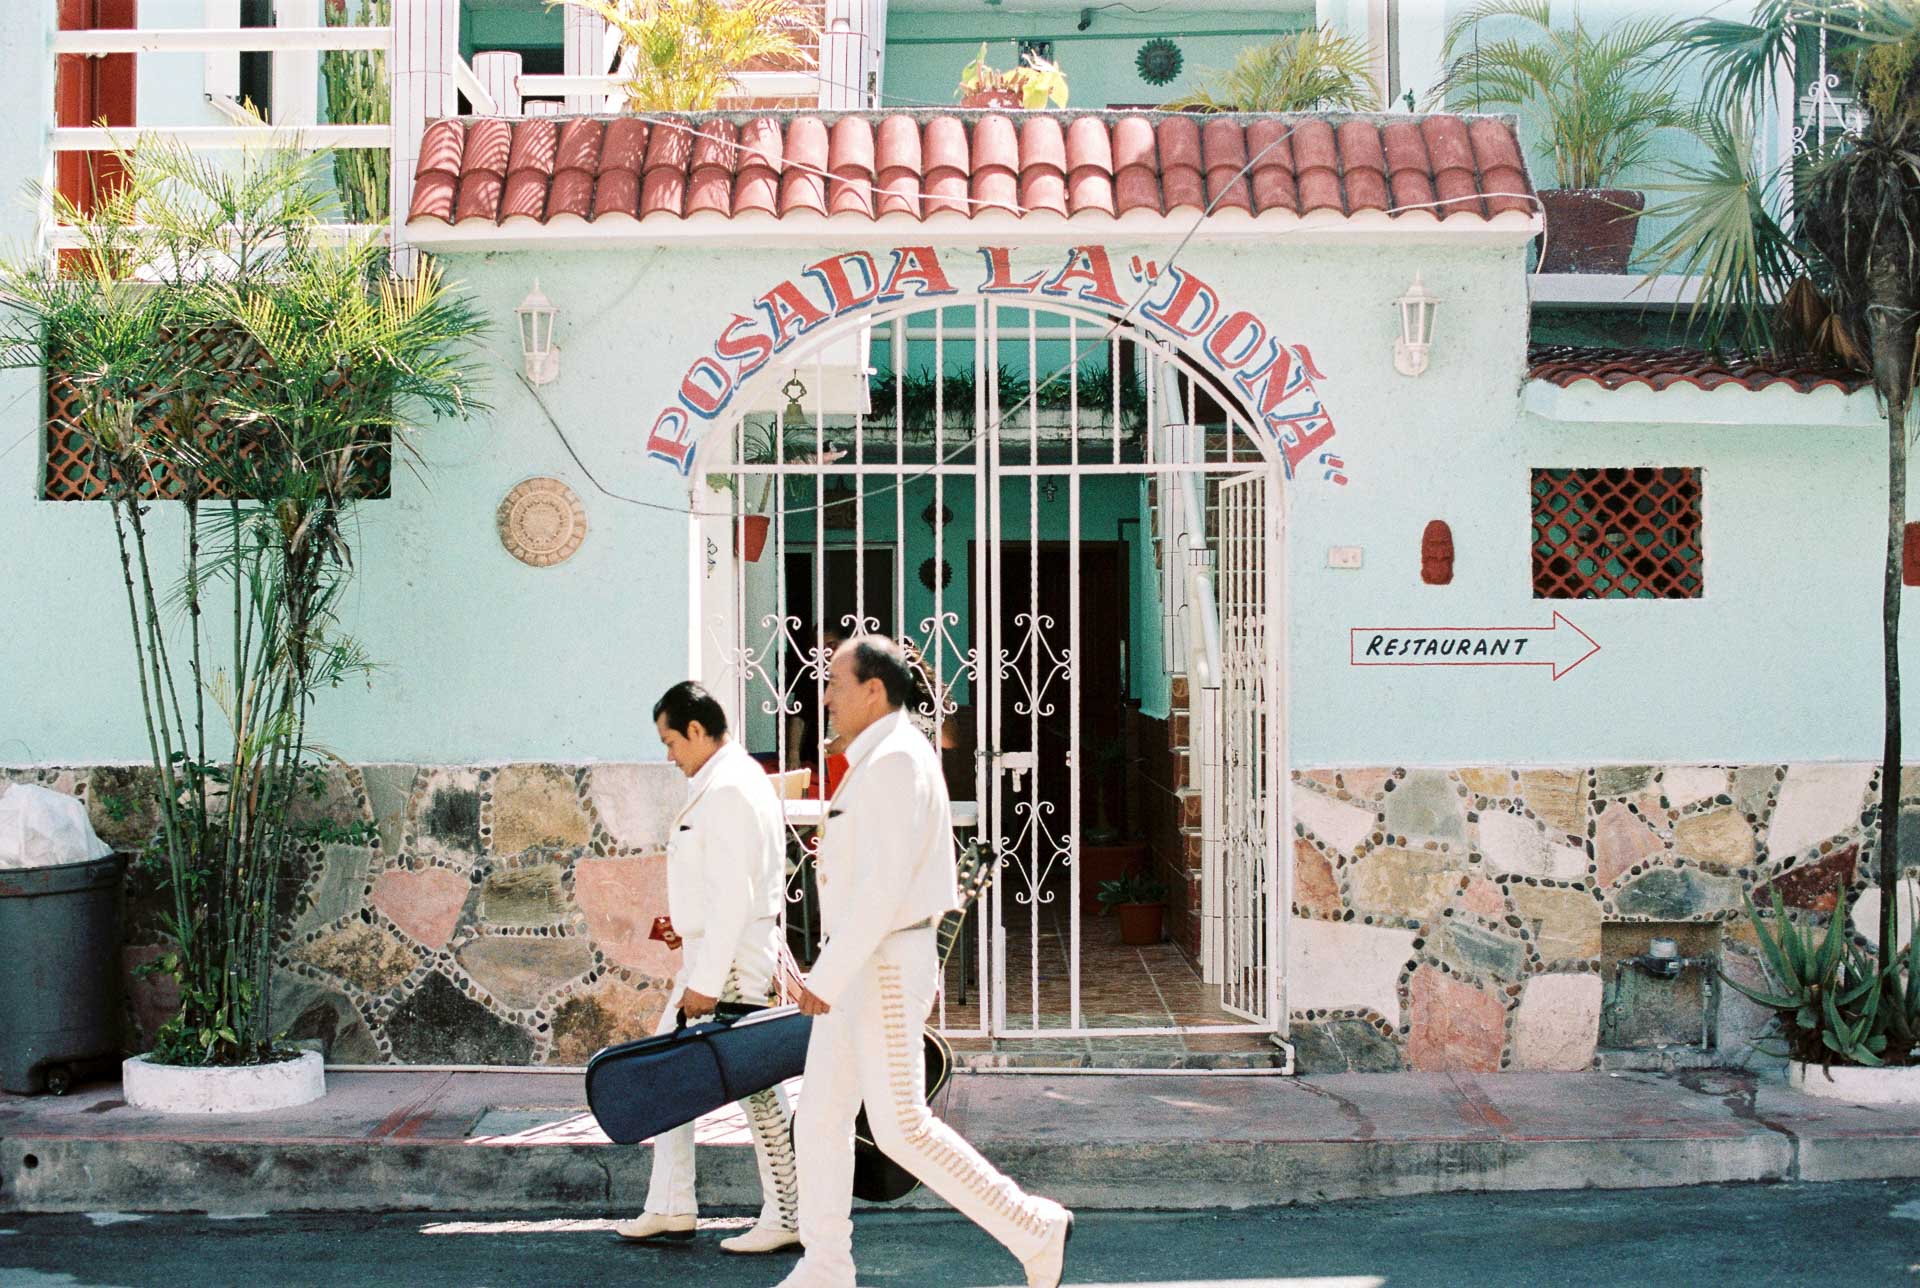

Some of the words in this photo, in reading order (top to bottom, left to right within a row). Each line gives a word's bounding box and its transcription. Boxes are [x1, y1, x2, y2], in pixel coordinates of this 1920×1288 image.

[647, 246, 958, 476] POSADA
[977, 245, 1129, 309] LA
[1366, 635, 1528, 656] RESTAURANT
